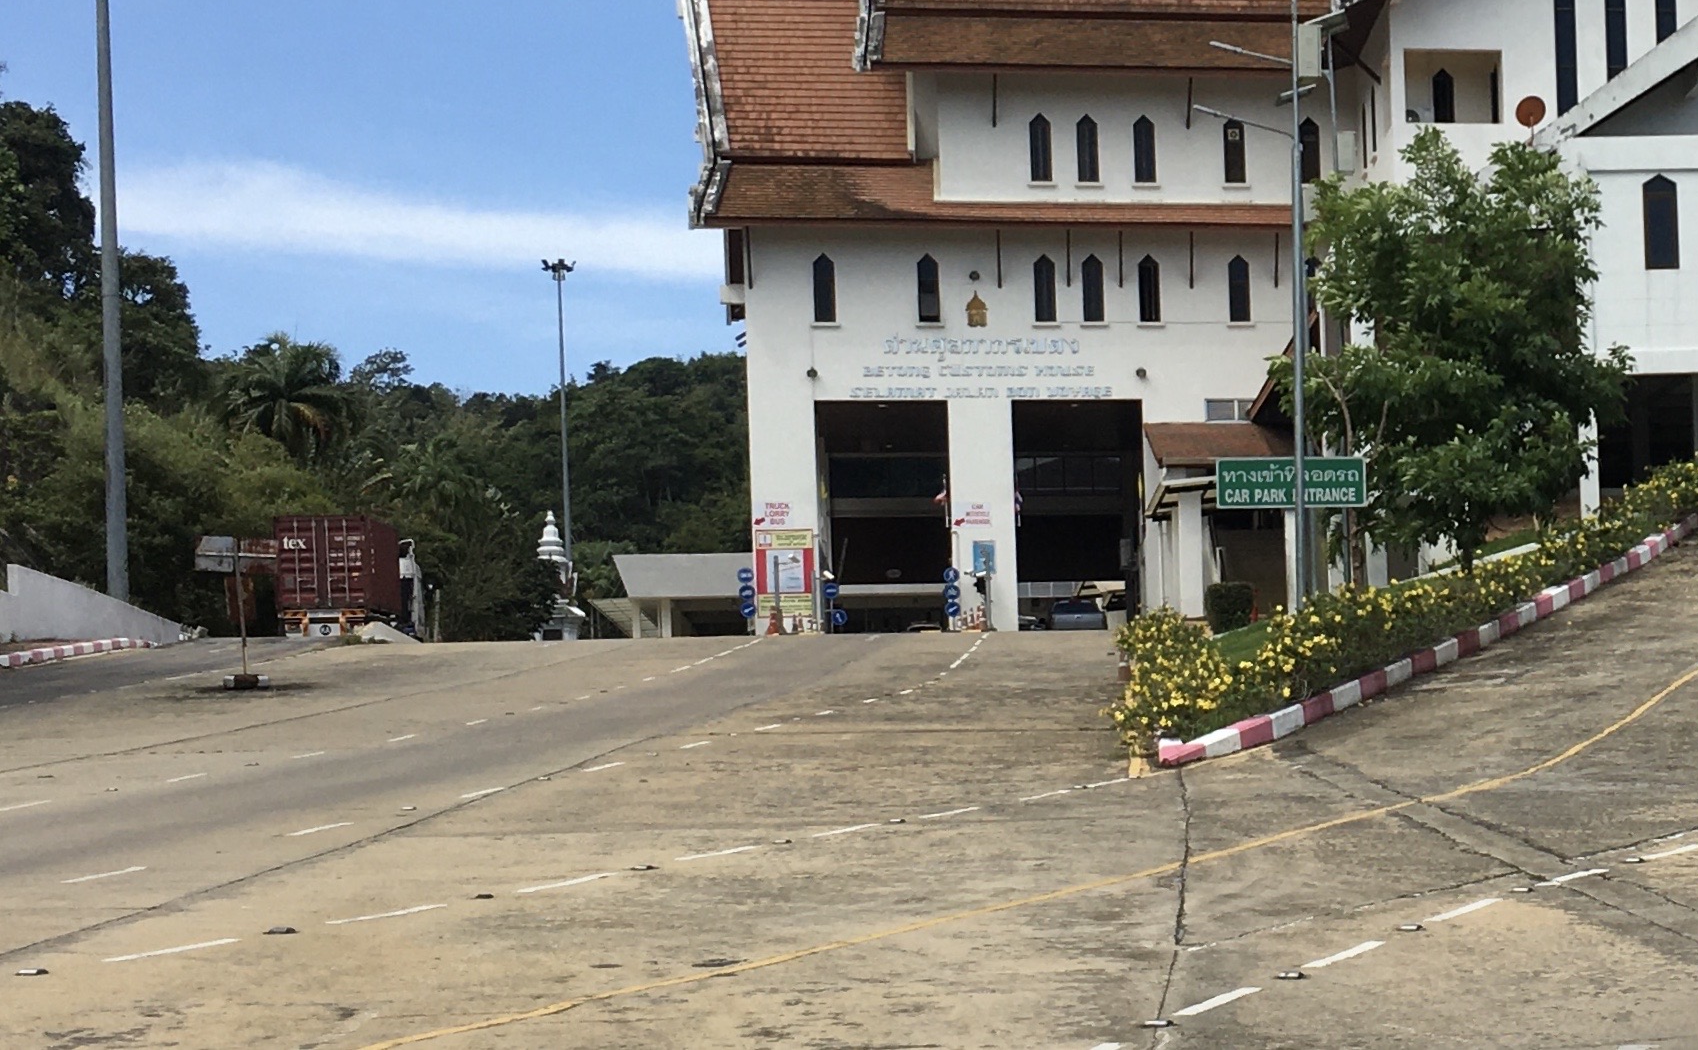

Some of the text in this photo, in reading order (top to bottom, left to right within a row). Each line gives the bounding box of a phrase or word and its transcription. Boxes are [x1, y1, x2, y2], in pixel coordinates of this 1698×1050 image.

[862, 365, 1096, 378] BETONG CUSTOMS HOUSE
[849, 386, 1113, 400] SELAMAT JALAN BON VOYAGE
[1224, 488, 1250, 503] CAR
[1254, 487, 1287, 503] PARK
[765, 502, 790, 510] TRUCK
[764, 510, 790, 518] LORRY
[769, 518, 786, 526] BUS
[282, 535, 307, 550] tex
